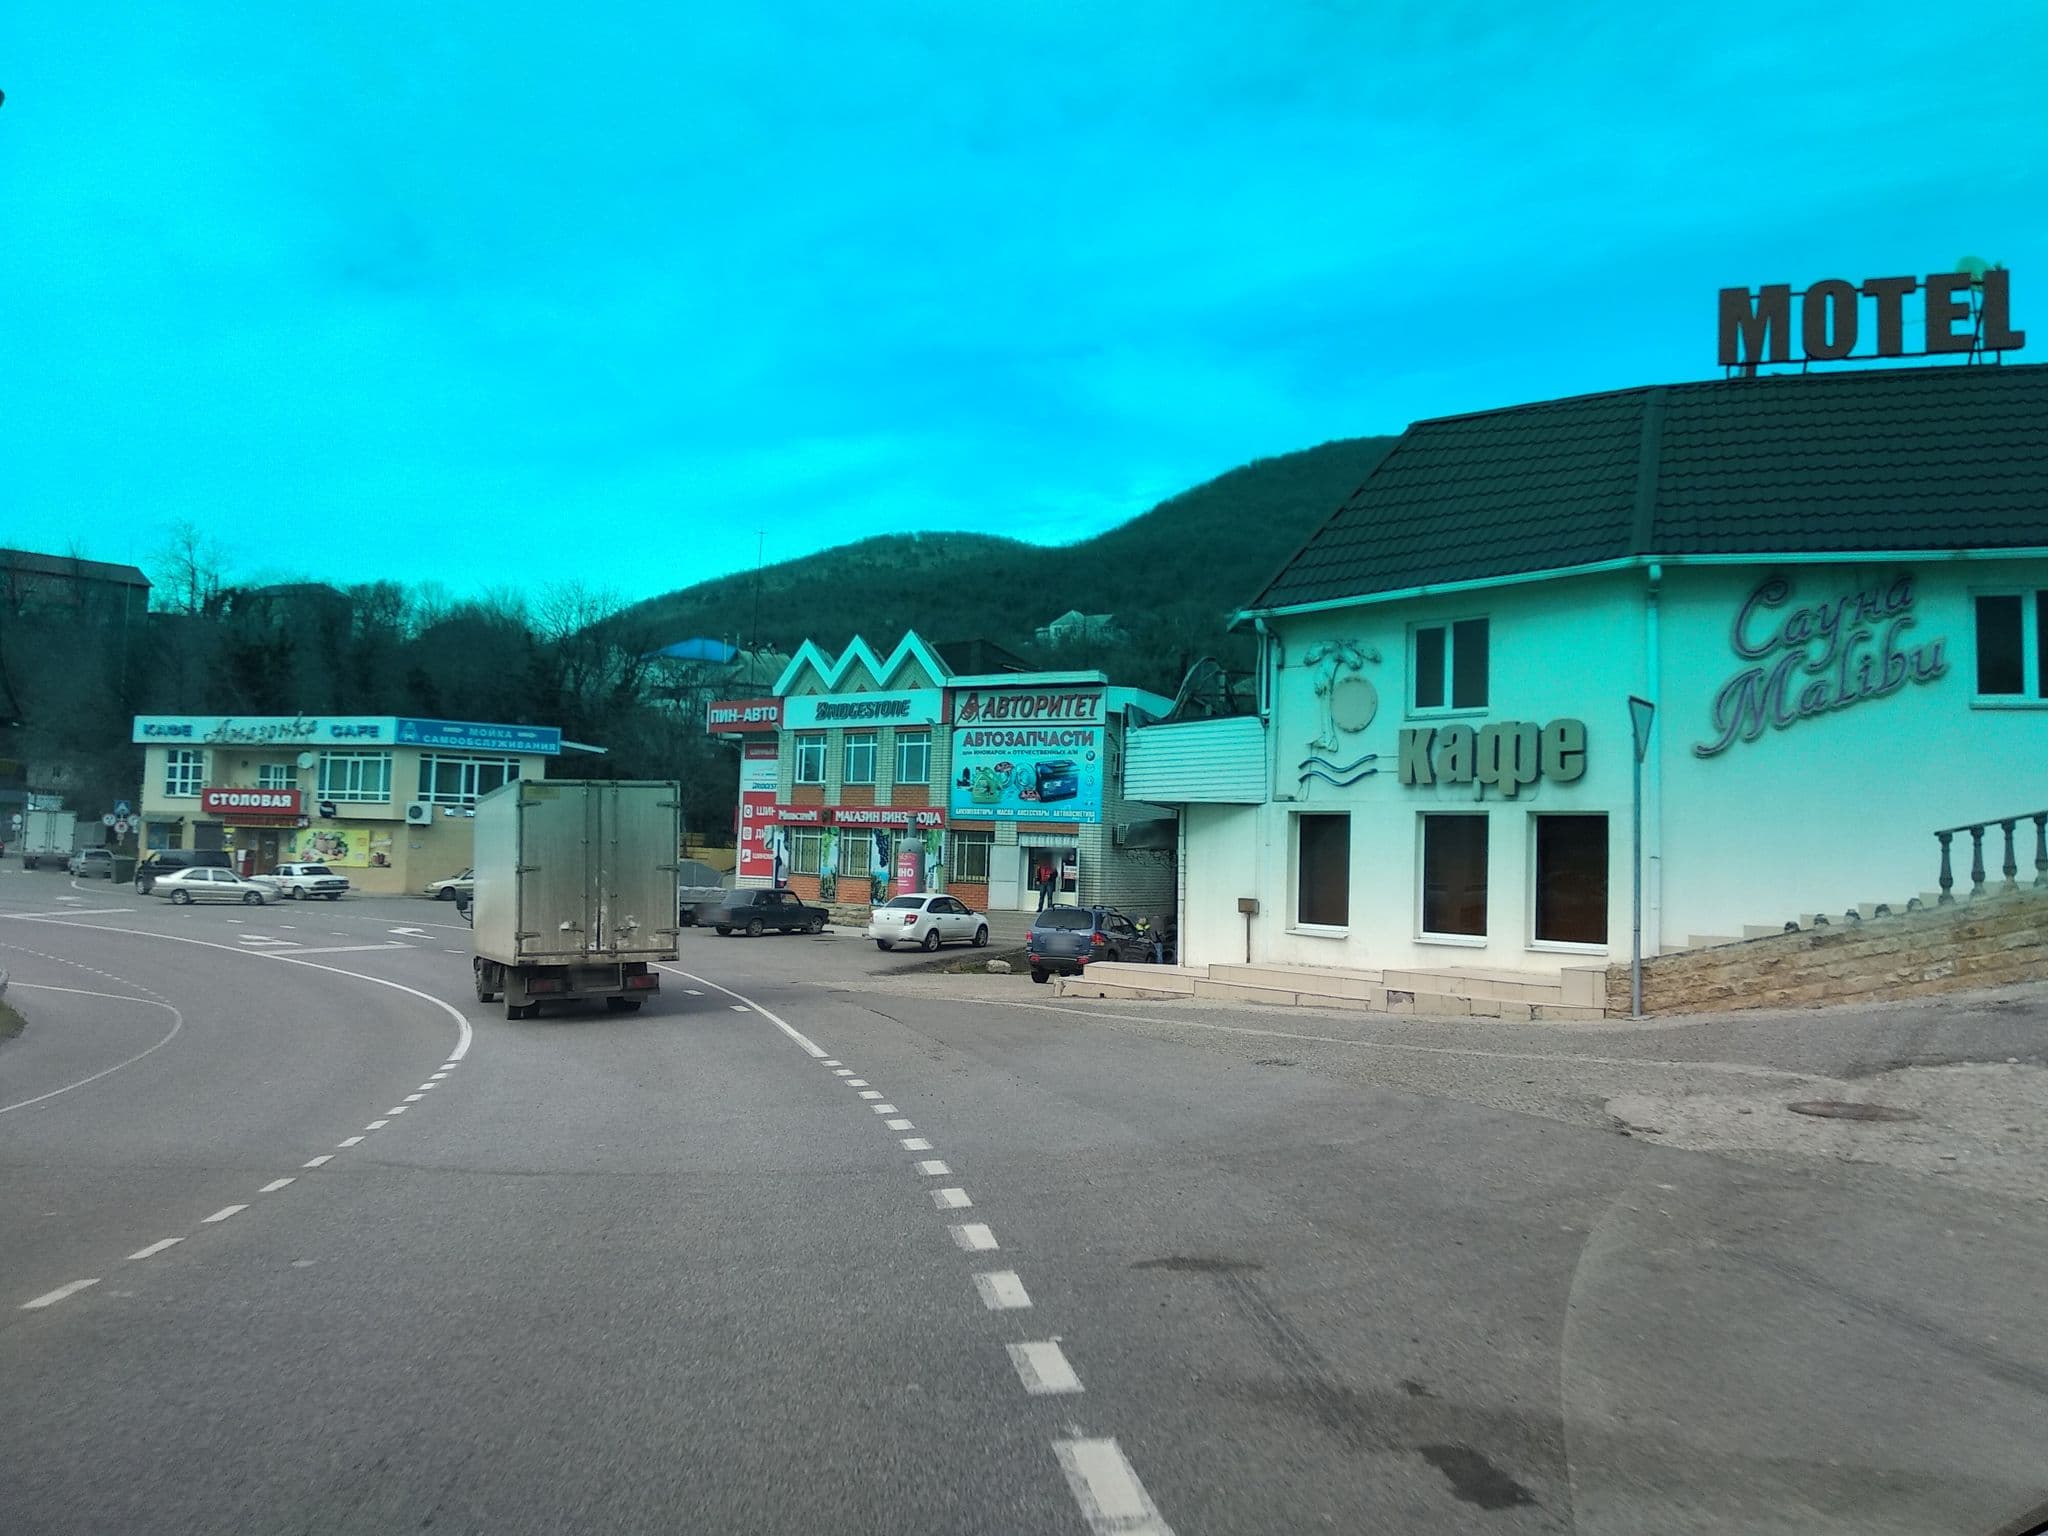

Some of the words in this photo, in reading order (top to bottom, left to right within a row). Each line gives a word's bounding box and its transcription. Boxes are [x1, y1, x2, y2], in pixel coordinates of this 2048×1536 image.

[1719, 269, 2025, 366] MOTEL
[1732, 577, 1916, 677] Сауна
[1692, 618, 1948, 759] Malibu
[711, 706, 778, 724] ПИН-АВТО
[816, 699, 911, 721] BRIDGESTONE
[982, 694, 1103, 719] АВТОРИТЕТ
[423, 734, 557, 751] САМООБСЛУЖИВАНИЯ
[469, 727, 513, 738] МОЙКА
[963, 731, 1095, 748] АВТОЗАПЧАСТИ
[1398, 718, 1586, 797] кафе
[209, 793, 292, 808] СТОЛОВАЯ
[835, 810, 881, 823] МАГАЗИН
